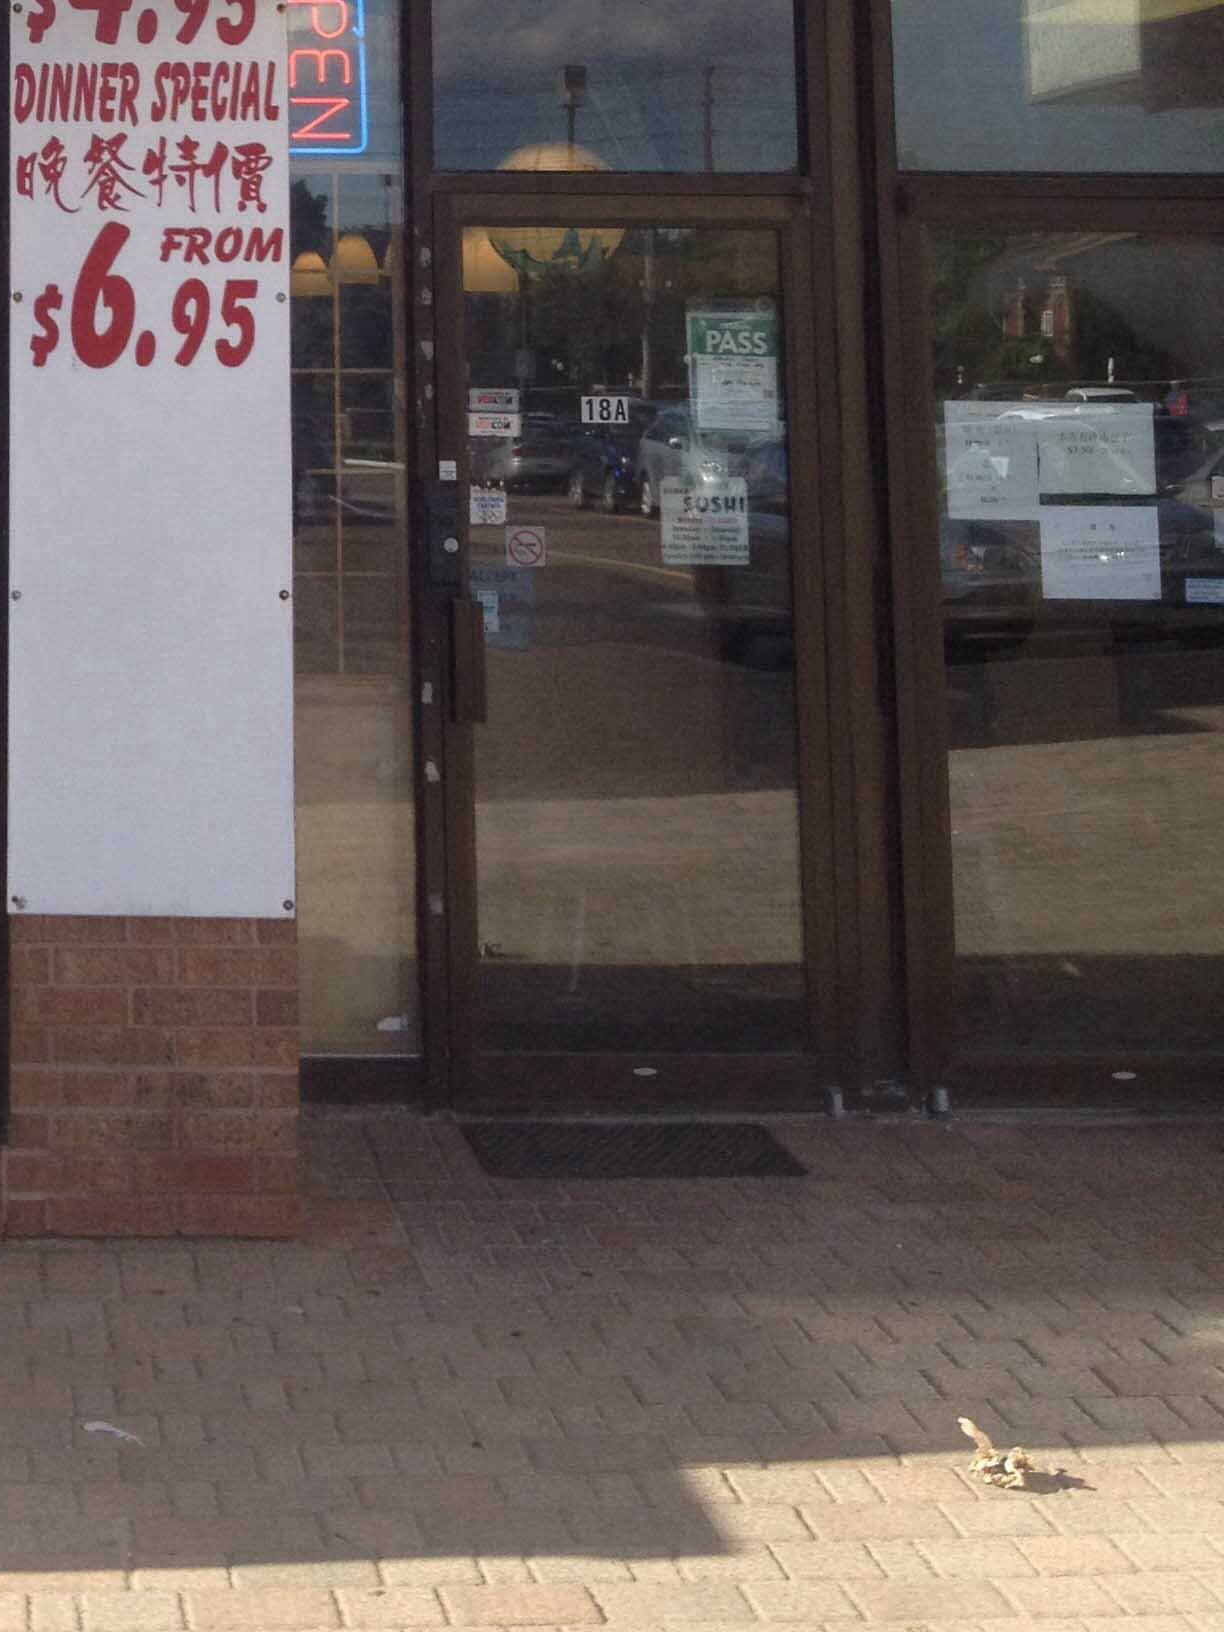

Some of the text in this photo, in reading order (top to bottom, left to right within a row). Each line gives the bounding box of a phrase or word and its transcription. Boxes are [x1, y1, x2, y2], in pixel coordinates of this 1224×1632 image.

[13, 60, 281, 128] DINNER SPECIAL
[16, 132, 270, 214] 晚餐特價
[160, 226, 284, 266] FROM
[29, 220, 259, 369] $6.95
[705, 328, 769, 355] PASS
[584, 398, 627, 422] 18A
[683, 495, 745, 514] SUSHI
